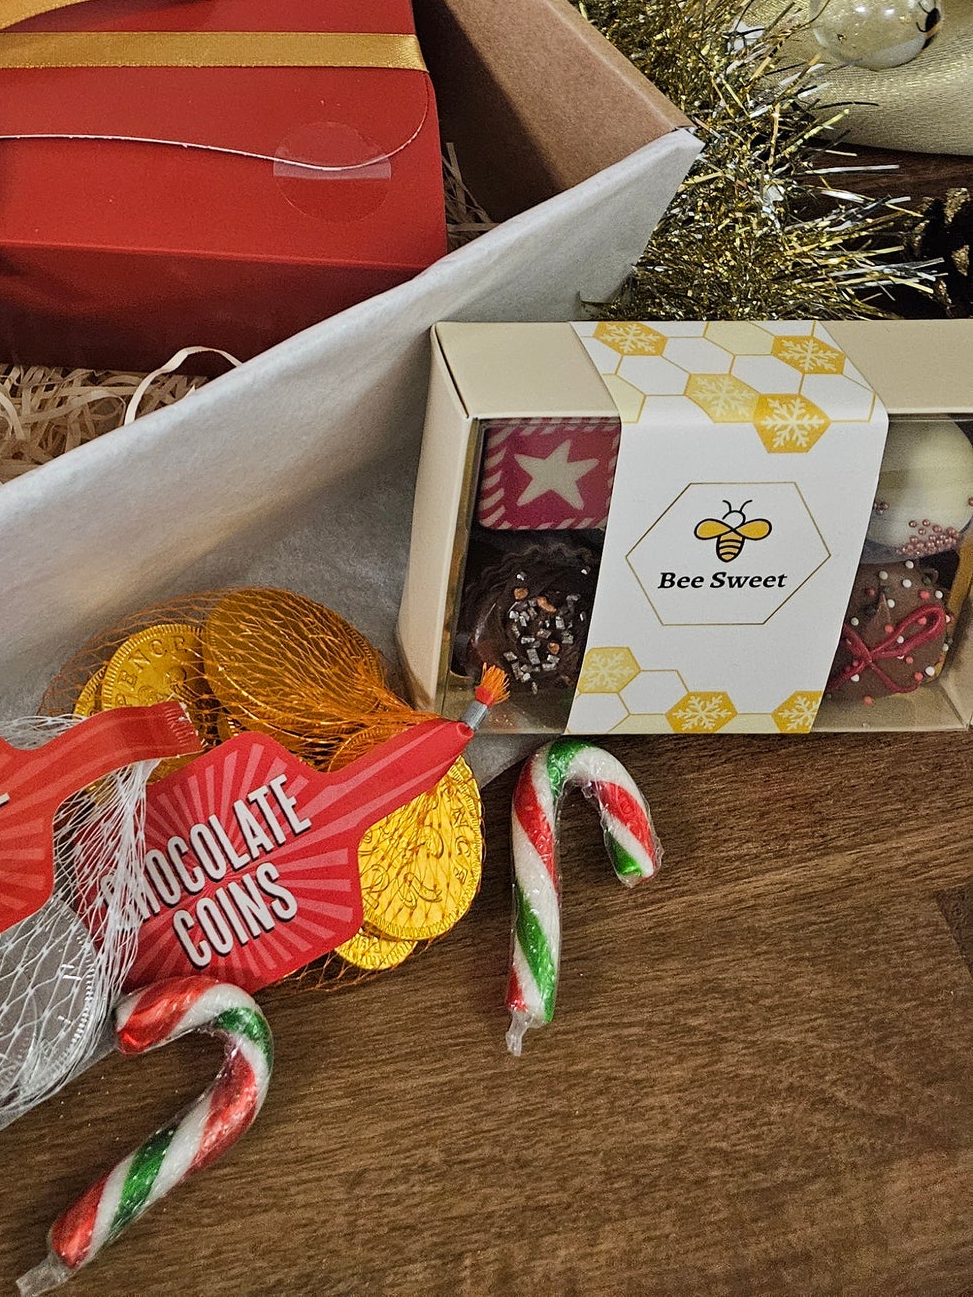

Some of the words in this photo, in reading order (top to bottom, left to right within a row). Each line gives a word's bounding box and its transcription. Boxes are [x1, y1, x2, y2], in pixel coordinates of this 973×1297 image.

[658, 572, 704, 589] Bee
[710, 571, 787, 588] Sweet
[173, 862, 299, 968] COINS
